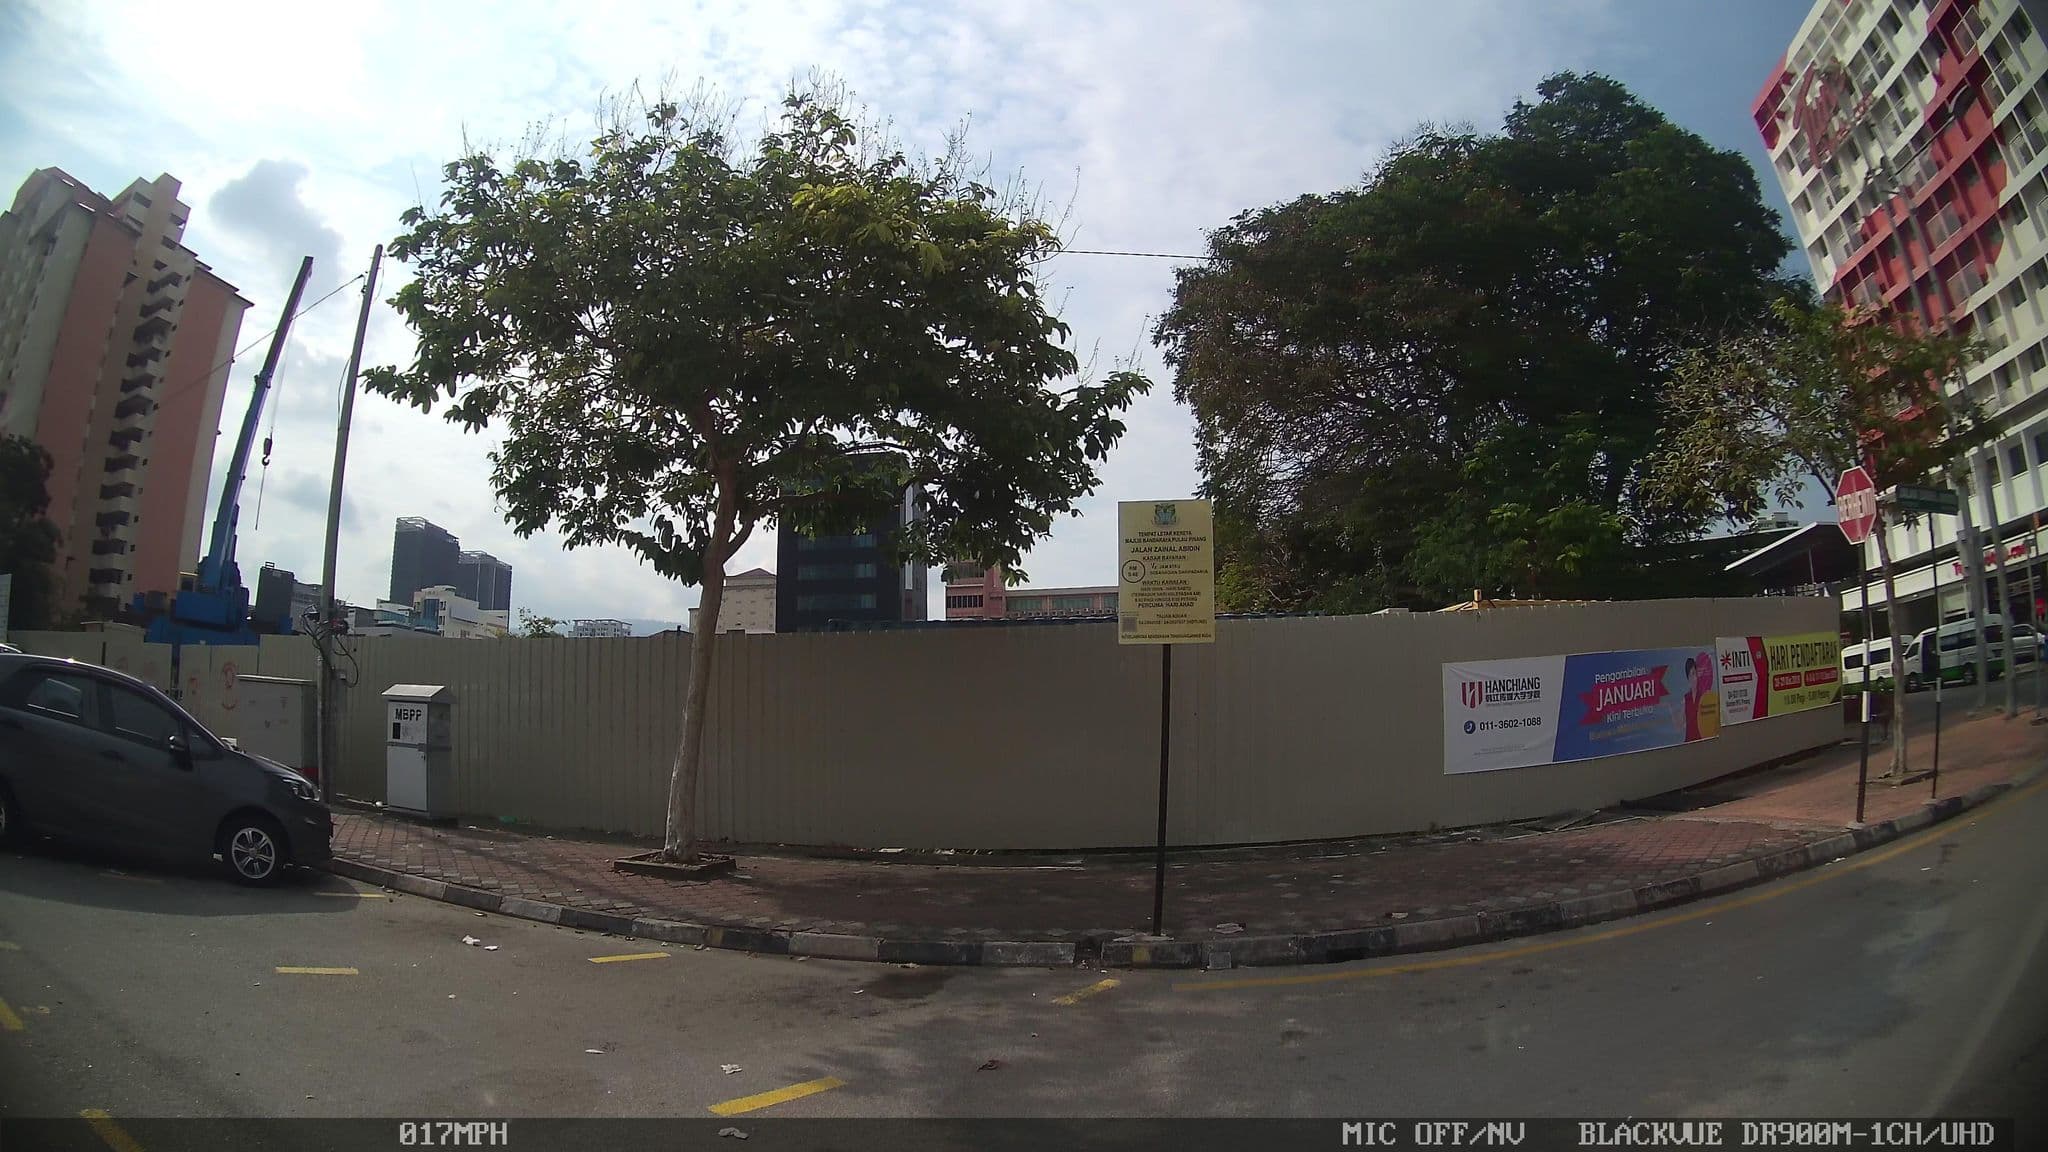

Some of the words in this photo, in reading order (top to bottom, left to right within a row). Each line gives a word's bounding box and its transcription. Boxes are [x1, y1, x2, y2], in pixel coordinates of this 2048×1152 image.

[1732, 651, 1750, 668] INTI
[1770, 644, 1789, 671] HARI
[1595, 667, 1648, 684] Pengambilan
[1485, 677, 1541, 693] HANCHIANG
[1596, 680, 1655, 712] JANUARI
[395, 708, 422, 721] MBPP
